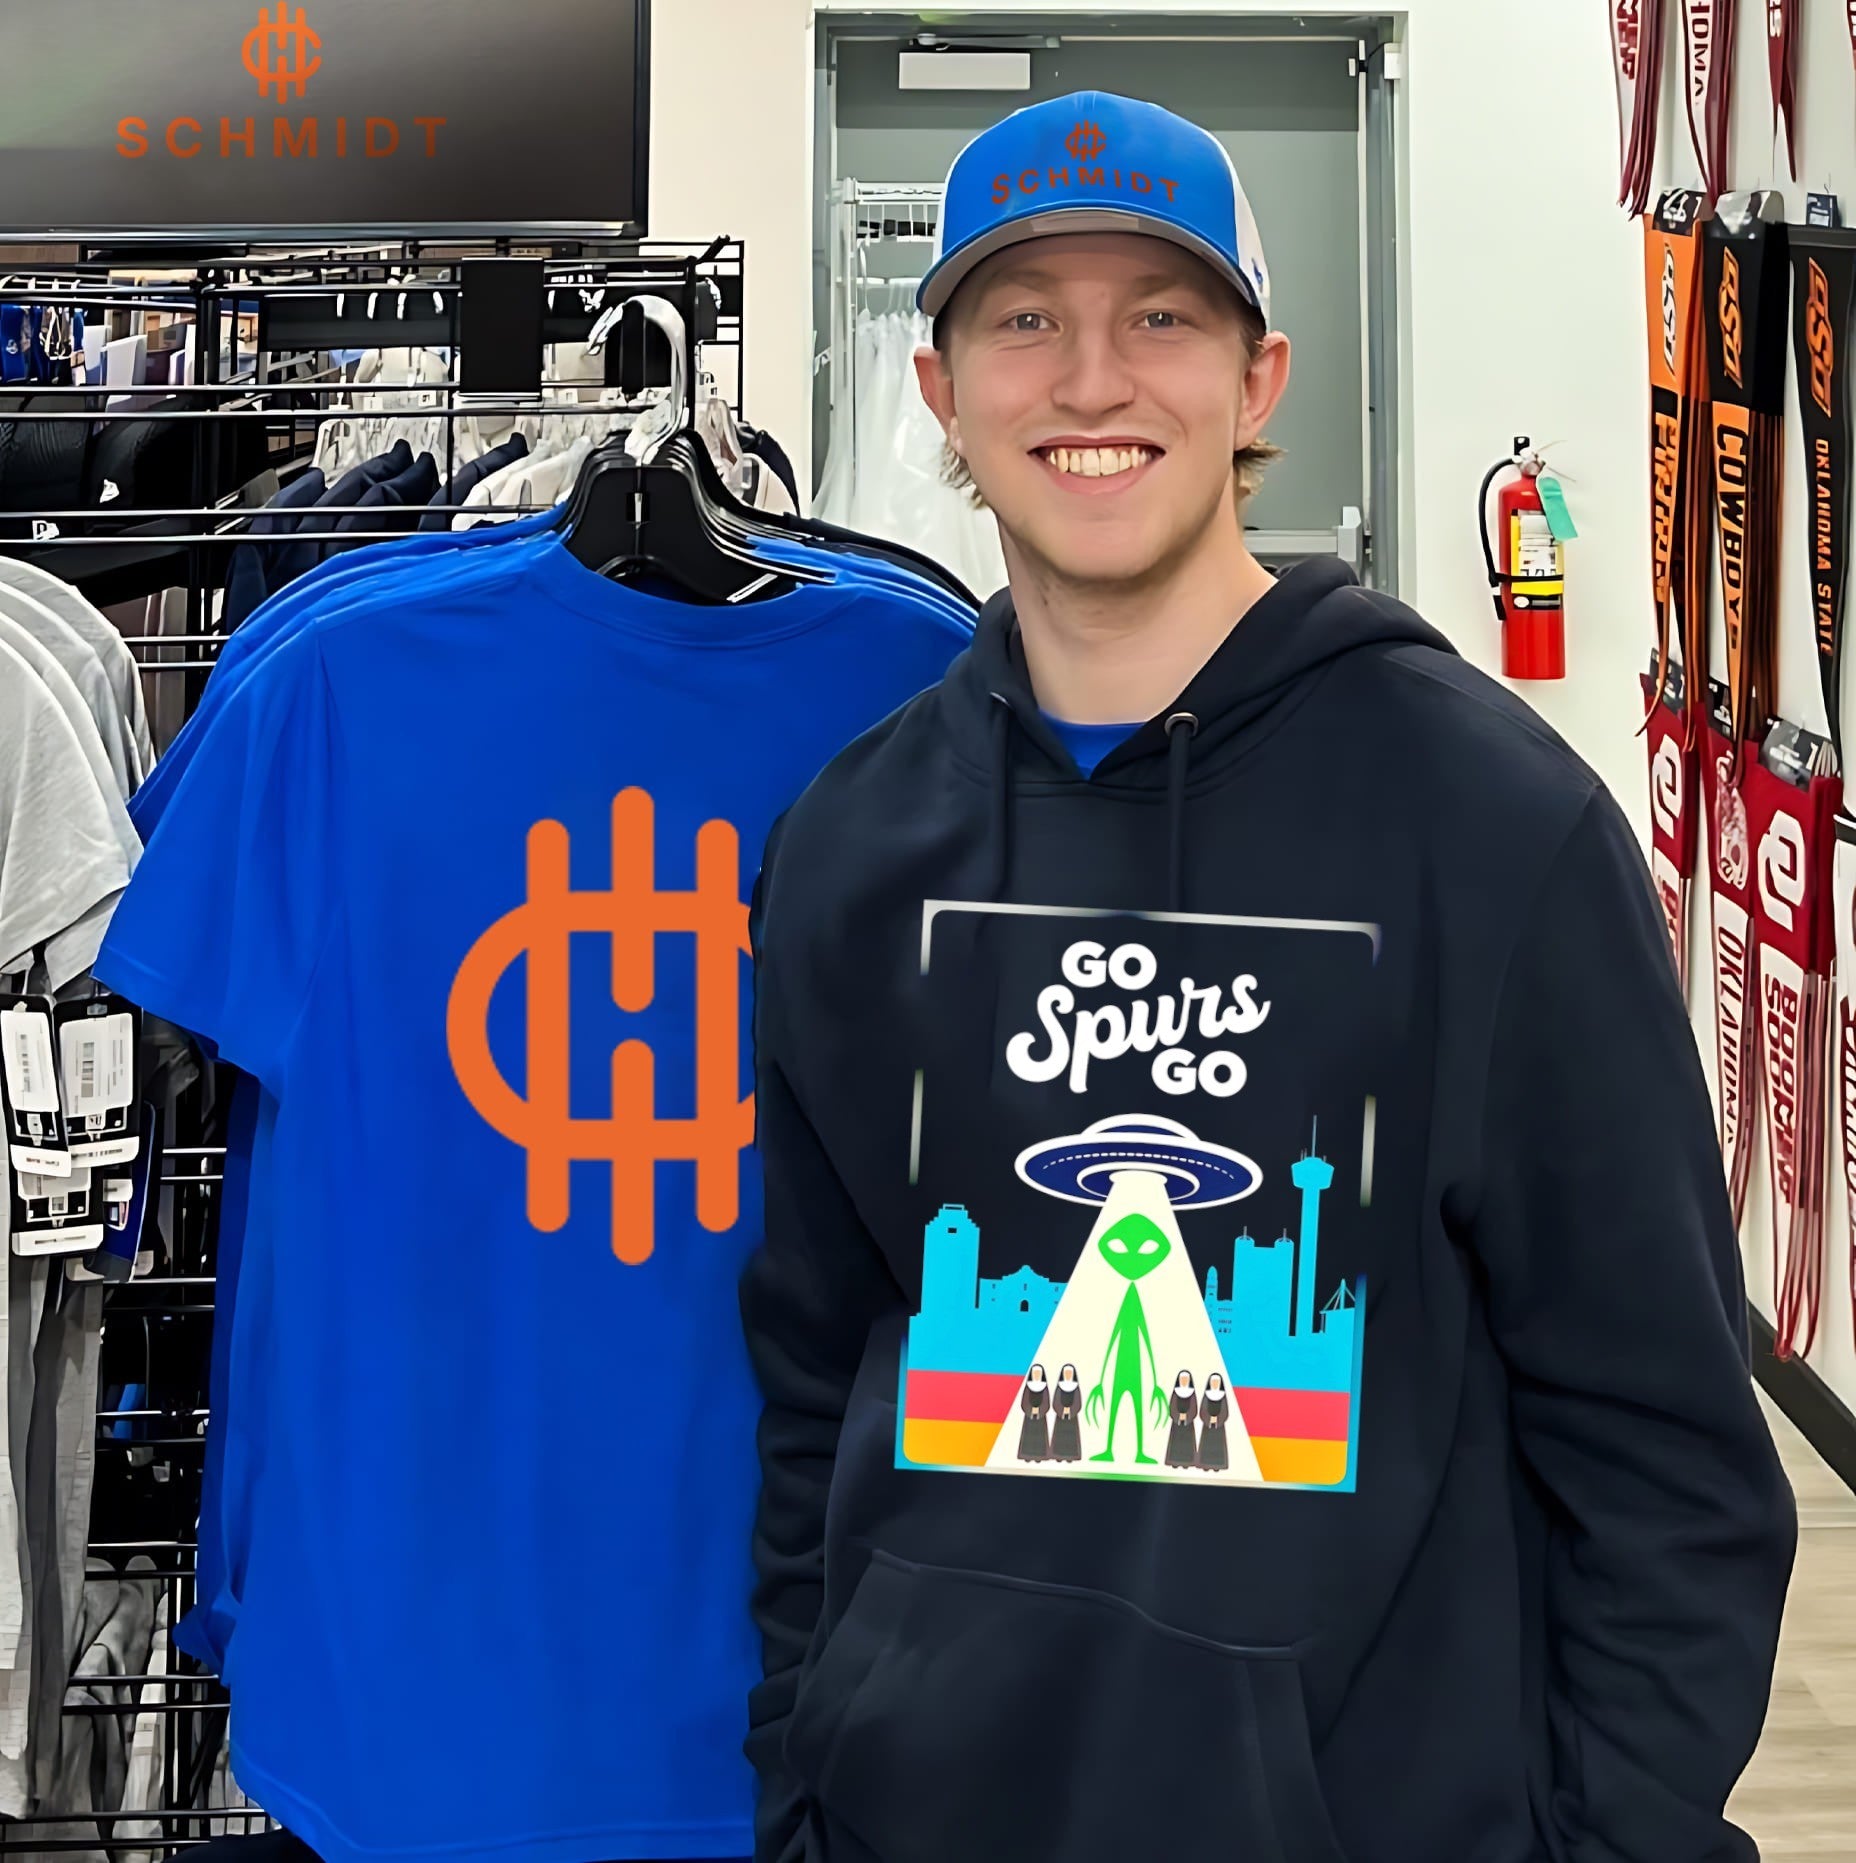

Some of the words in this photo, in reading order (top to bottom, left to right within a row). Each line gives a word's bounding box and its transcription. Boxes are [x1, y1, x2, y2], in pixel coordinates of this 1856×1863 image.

[115, 116, 448, 159] SCHMIDT
[992, 166, 1179, 205] SCHMIDT
[1716, 422, 1748, 650] COWBOY
[1061, 940, 1157, 990] GO
[1006, 973, 1271, 1093] Spurs
[1151, 1047, 1248, 1098] GO
